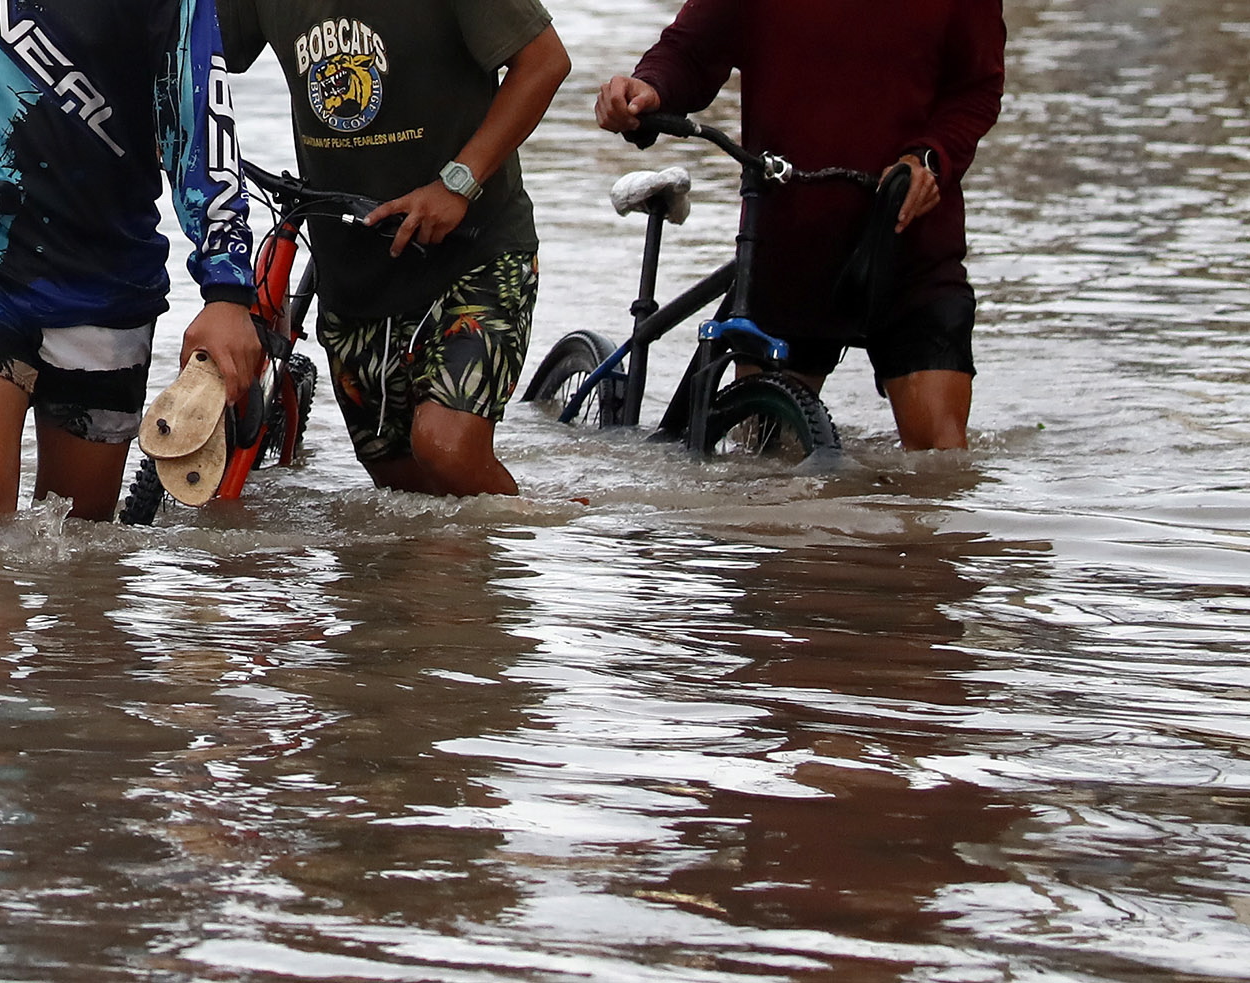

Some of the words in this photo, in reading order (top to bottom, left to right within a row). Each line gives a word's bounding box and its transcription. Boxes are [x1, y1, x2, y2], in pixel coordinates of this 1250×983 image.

[296, 18, 388, 74] BOBCATS
[310, 82, 338, 127] BRAVO
[353, 134, 387, 146] FEARLESS
[388, 133, 396, 142] IN
